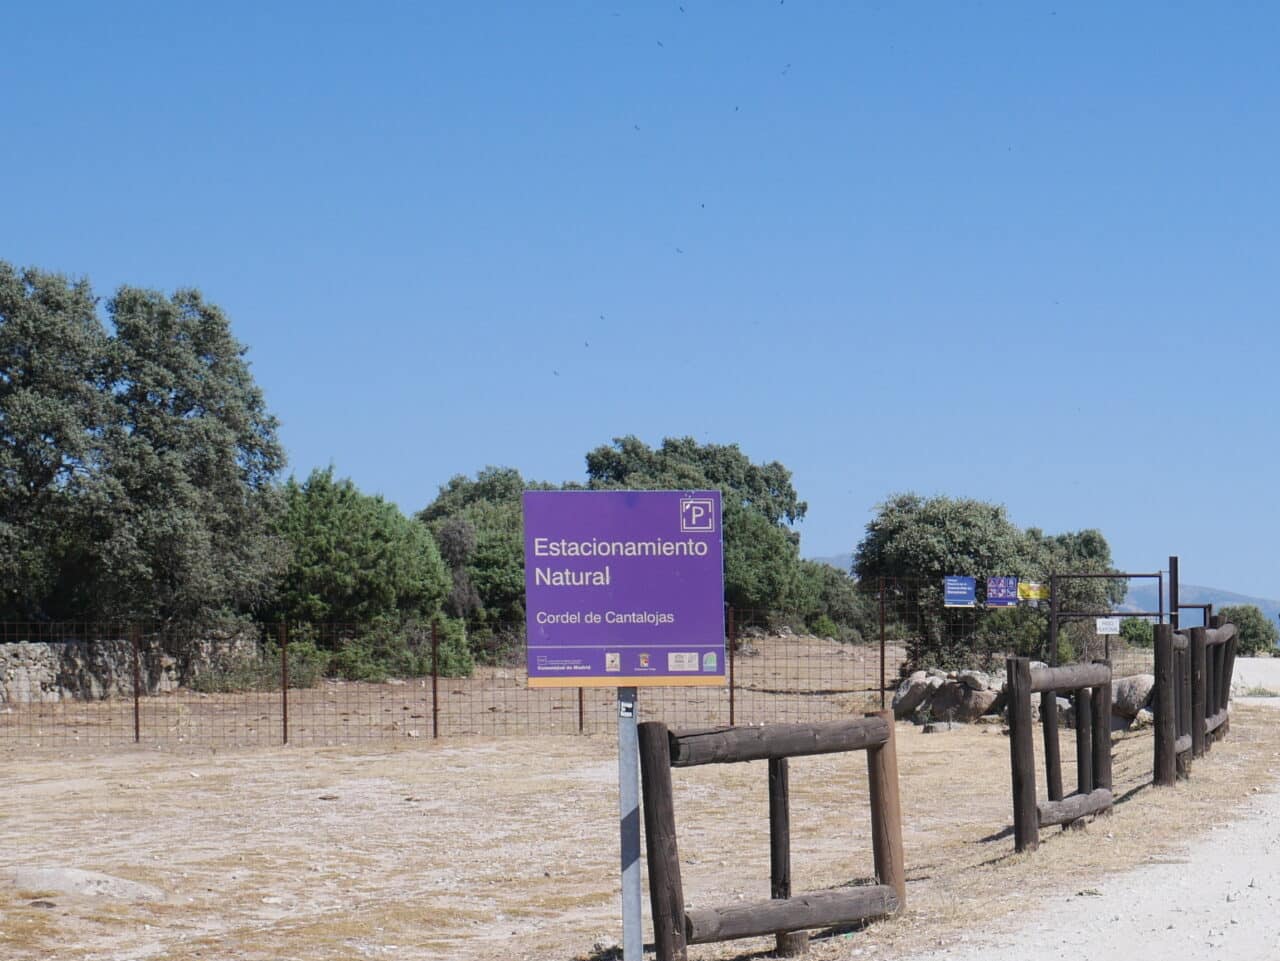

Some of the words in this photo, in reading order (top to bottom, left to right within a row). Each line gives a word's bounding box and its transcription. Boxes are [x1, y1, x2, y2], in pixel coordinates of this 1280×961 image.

[691, 505, 705, 525] P
[534, 537, 708, 557] Estacionamiento
[535, 566, 610, 586] Natural
[536, 611, 581, 624] Cordel
[584, 611, 602, 624] de
[605, 610, 675, 627] Cantalojas
